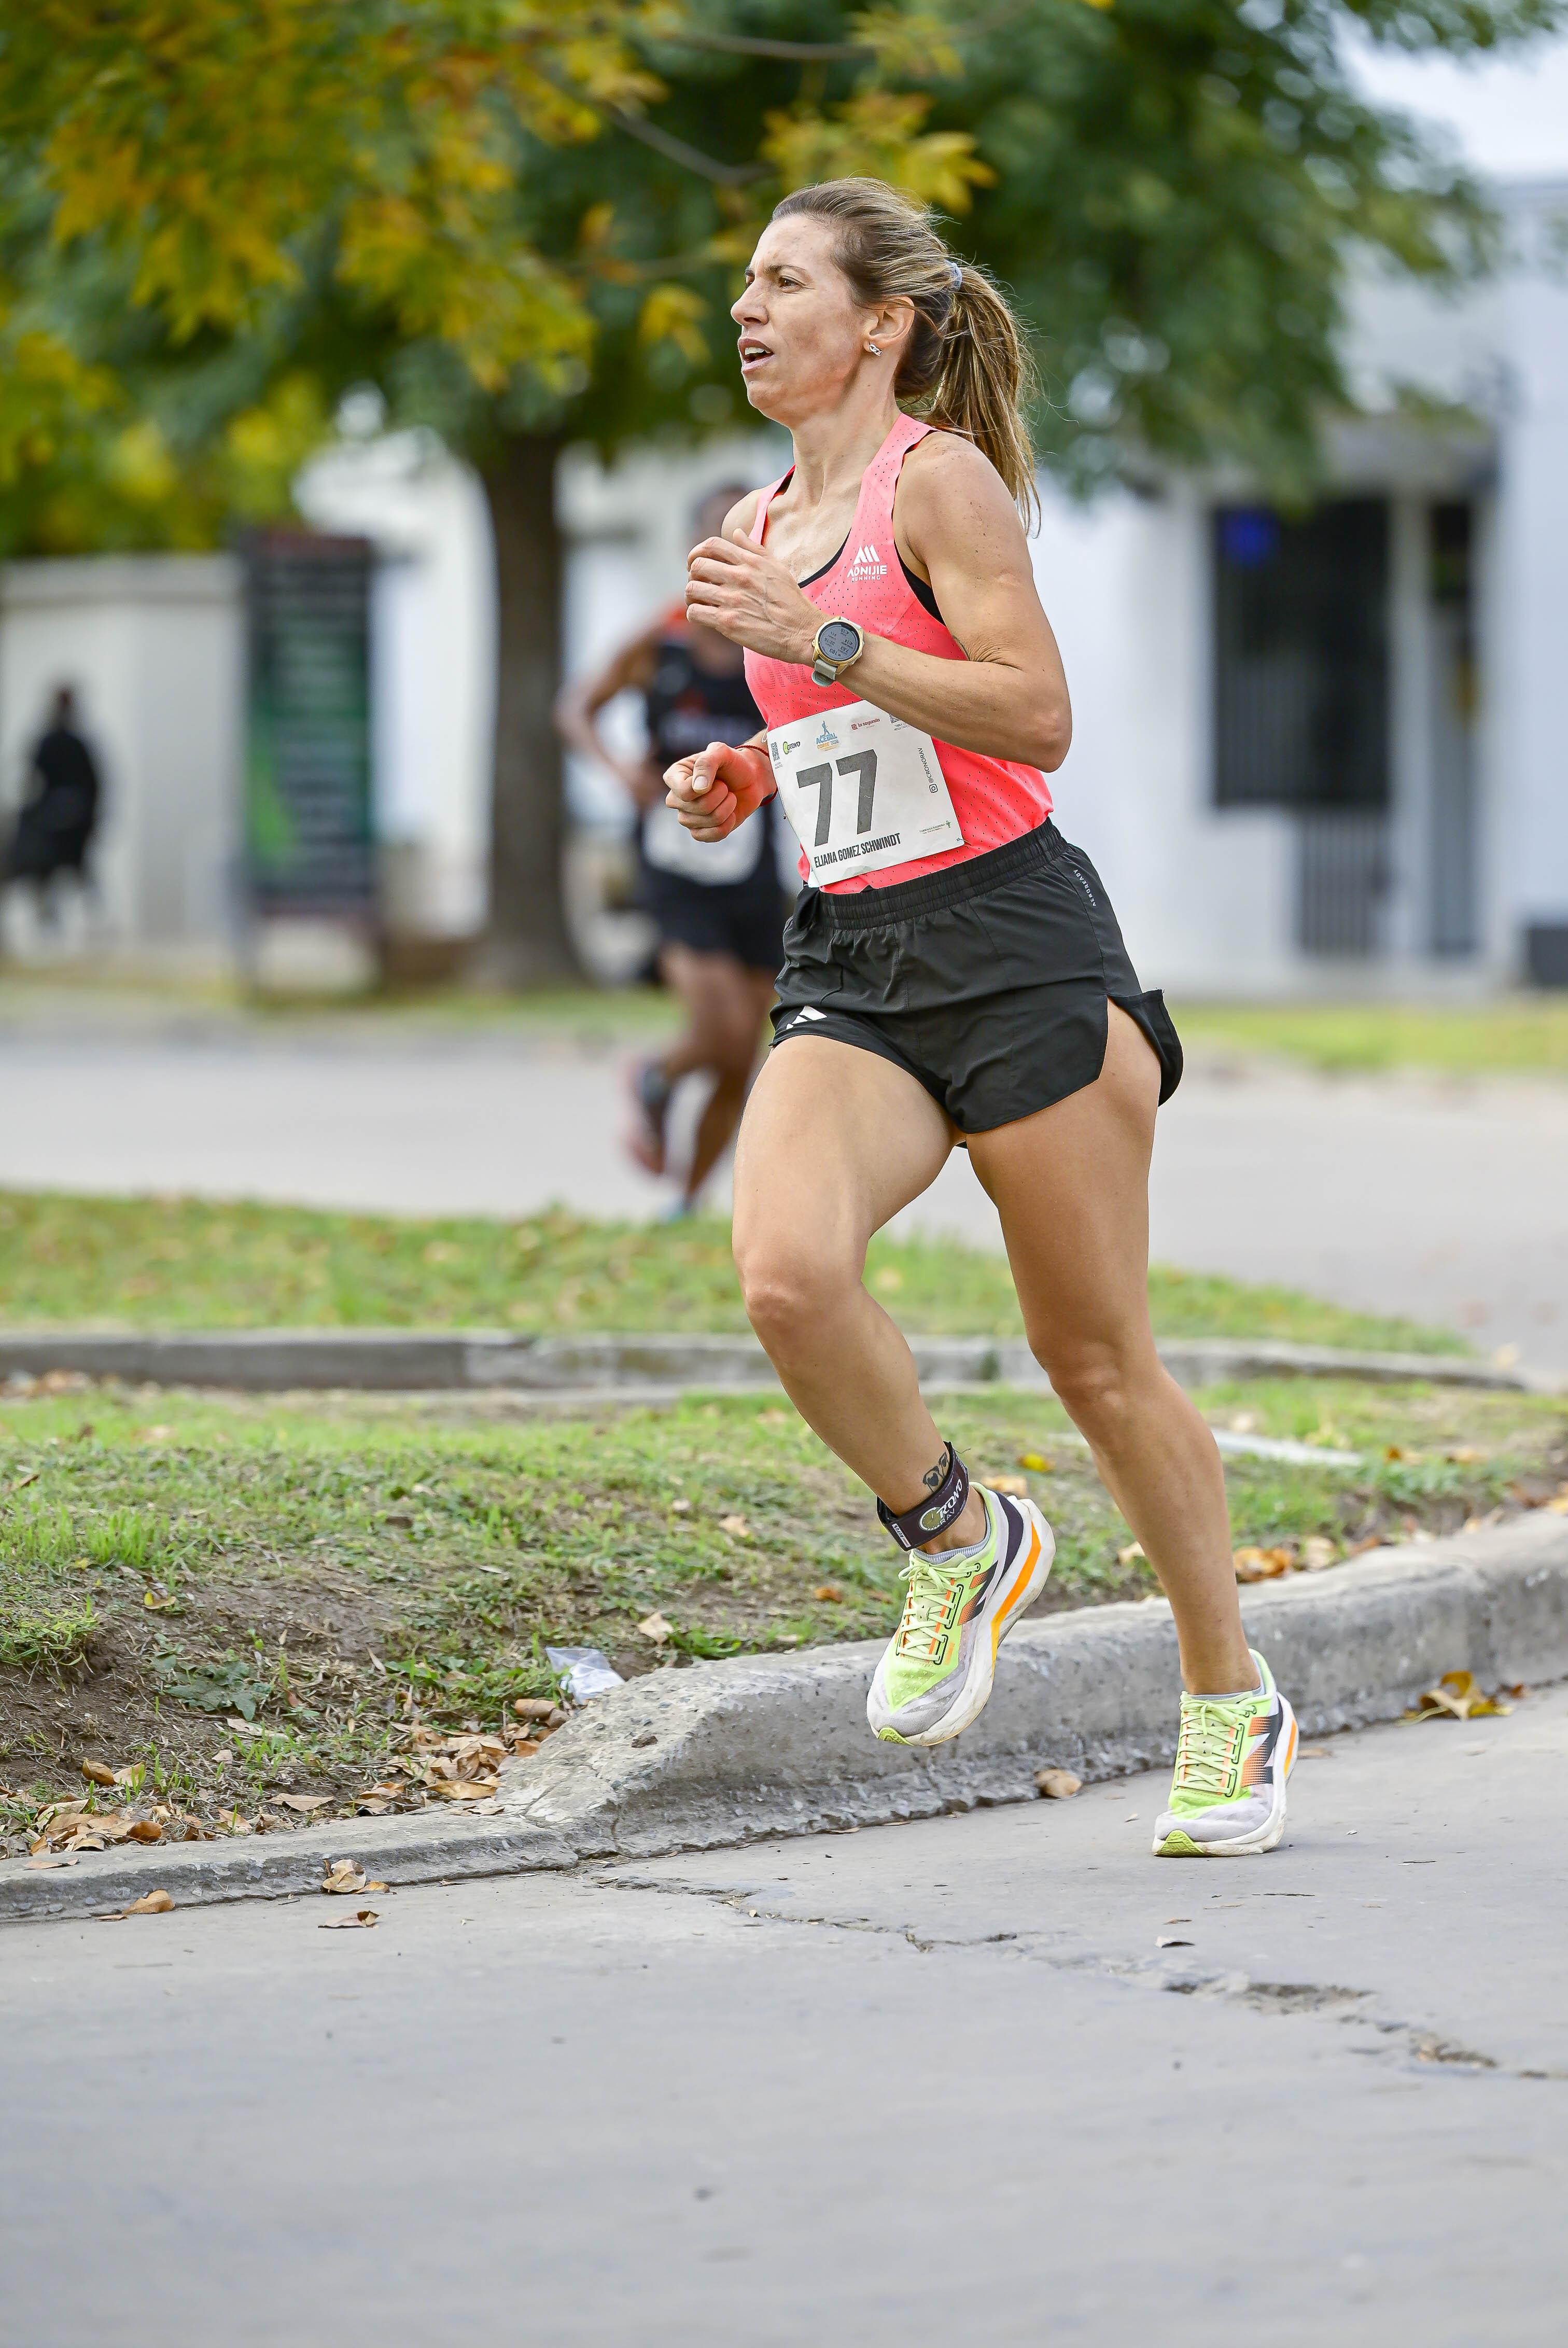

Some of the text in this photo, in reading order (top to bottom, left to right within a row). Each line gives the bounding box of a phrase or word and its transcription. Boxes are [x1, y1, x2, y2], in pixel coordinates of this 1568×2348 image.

[847, 565, 887, 578] AONIJIE
[917, 748, 934, 783] @CRONORAV
[796, 749, 877, 847] 77
[814, 833, 901, 868] ELIANA GOMEZ SCHWINDT
[1073, 869, 1096, 906] AEROREADY
[940, 1508, 955, 1525] RAV
